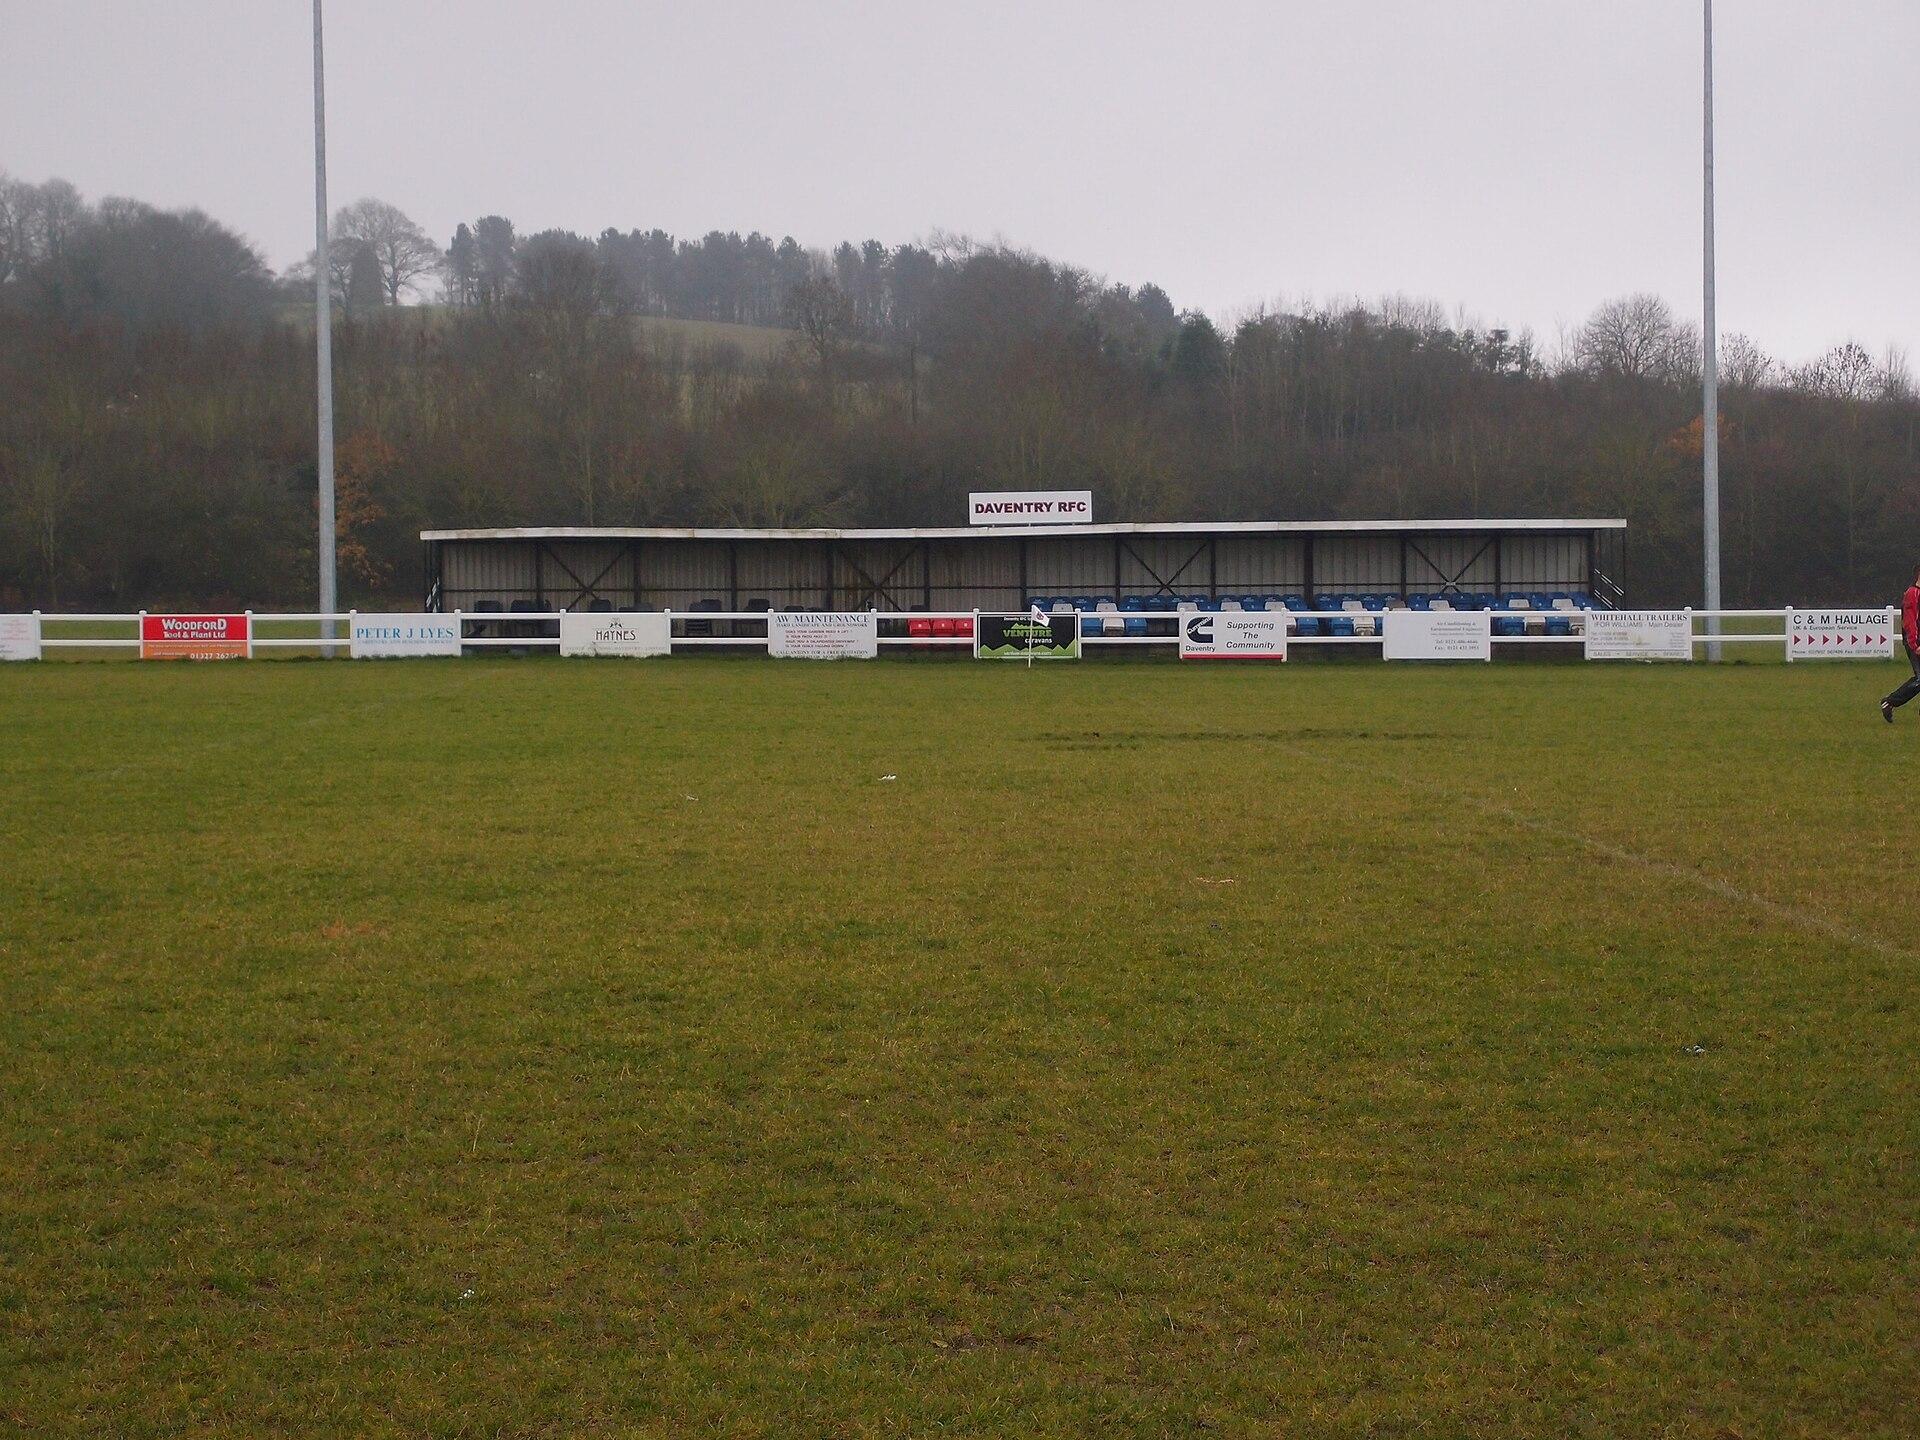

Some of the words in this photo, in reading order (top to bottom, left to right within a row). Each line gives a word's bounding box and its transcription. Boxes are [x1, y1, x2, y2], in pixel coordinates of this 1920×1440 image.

[975, 502, 1053, 514] DAVENTRY
[1058, 502, 1086, 512] RFC
[1794, 614, 1801, 624] C
[1807, 614, 1814, 624] &
[1821, 615, 1830, 624] M
[1835, 614, 1888, 624] HAULAGE
[1226, 622, 1274, 630] Supporting
[356, 628, 400, 638] PETER
[406, 628, 413, 638] J
[420, 628, 454, 638] LYES
[596, 630, 636, 640] HAYNES
